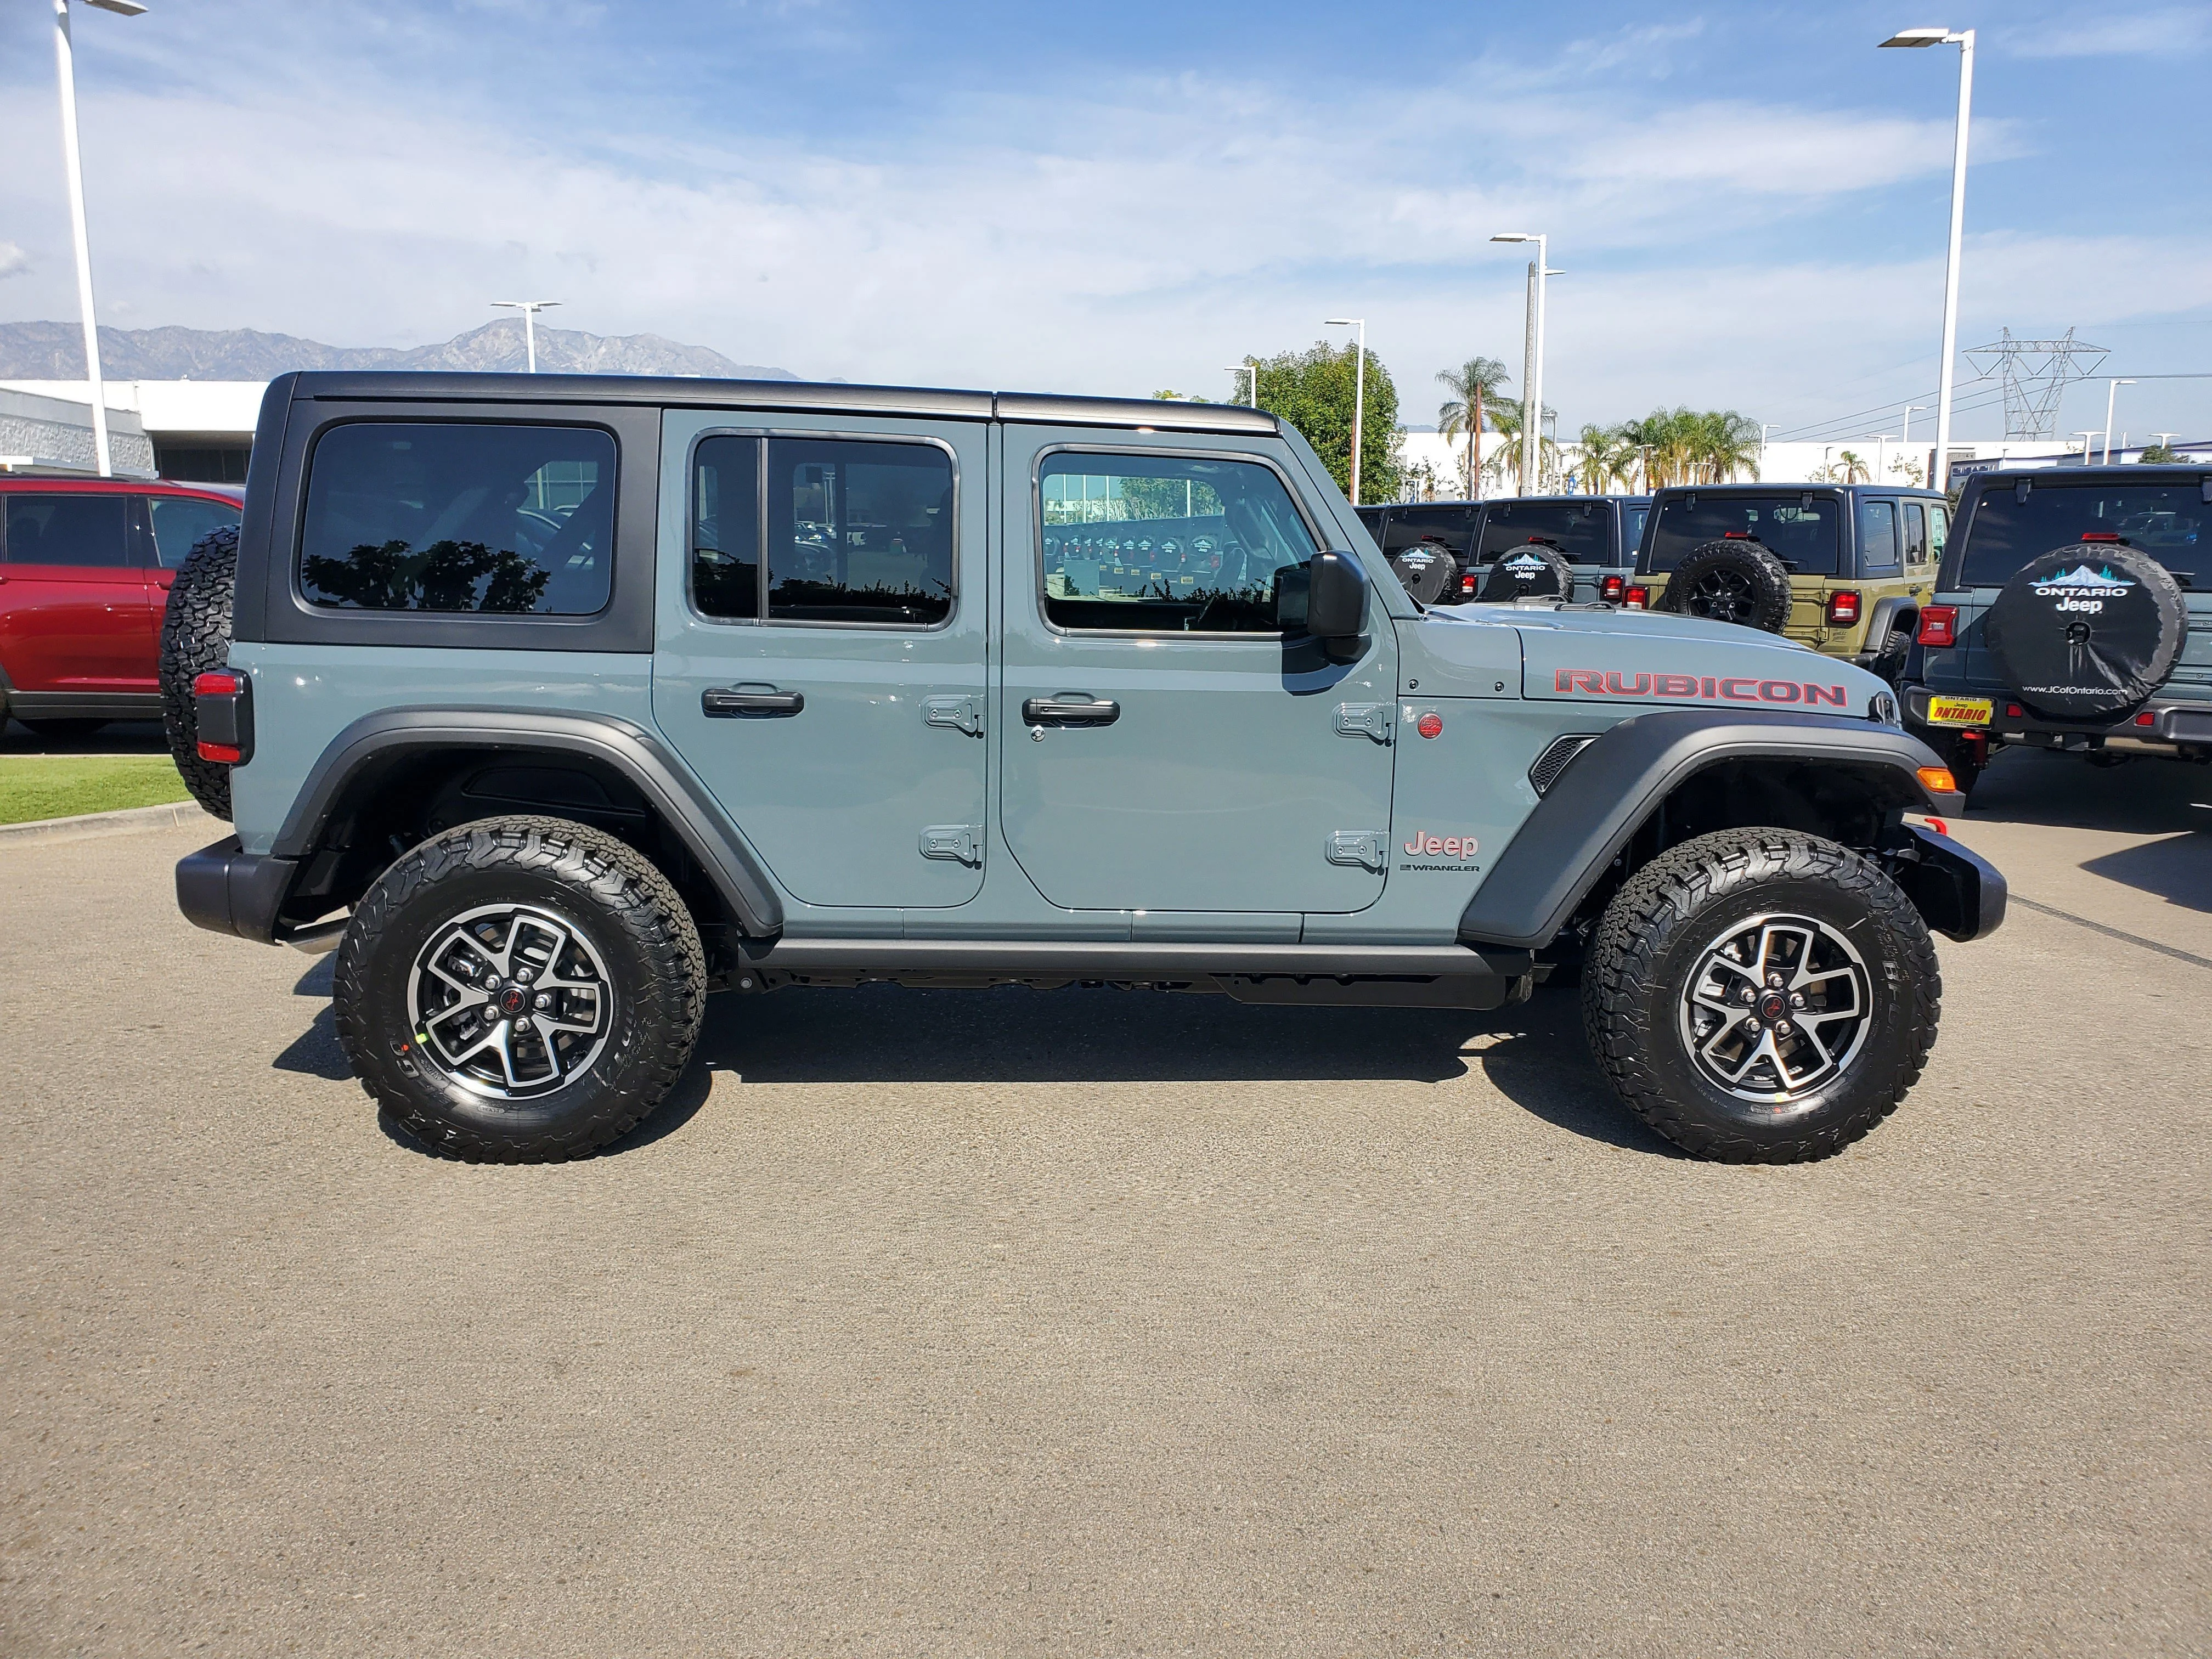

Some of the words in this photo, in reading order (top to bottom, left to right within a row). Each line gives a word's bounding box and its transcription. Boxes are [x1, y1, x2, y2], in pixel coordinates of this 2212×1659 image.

[1409, 562, 1425, 571] Jeep
[1515, 571, 1536, 579] Jeep
[2035, 588, 2128, 597] ONTARIO
[2056, 597, 2103, 614] Jeep
[1555, 669, 1848, 707] RUBICON
[2022, 686, 2129, 696] www.JCofOntario.com
[1934, 707, 1987, 721] ONTARIO
[1404, 830, 1479, 861] Jeep
